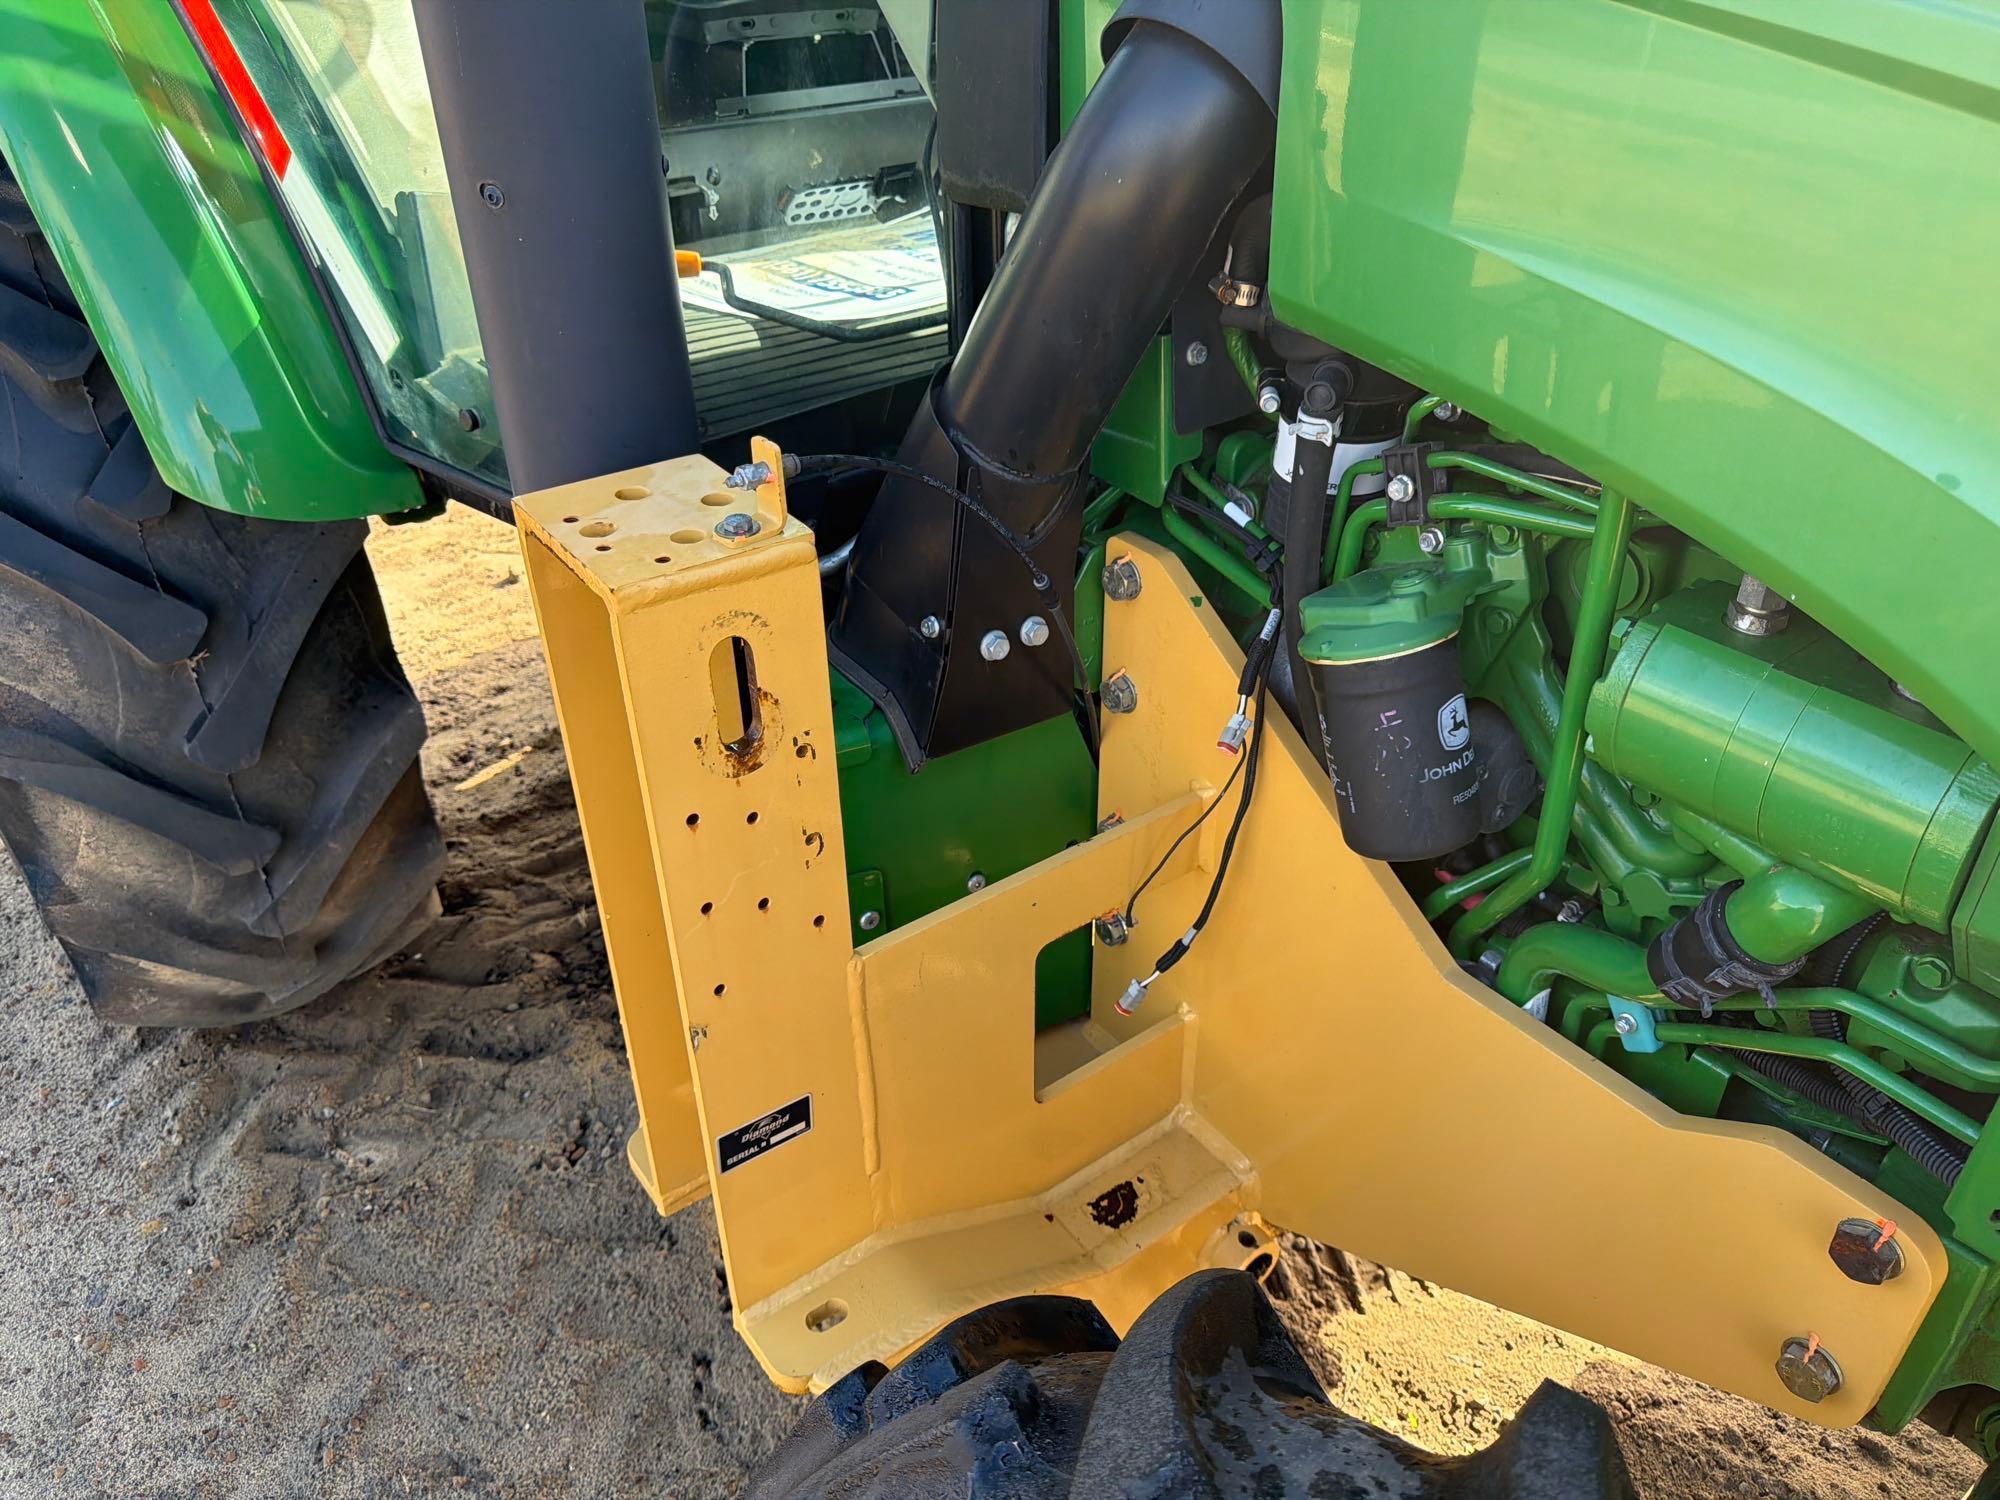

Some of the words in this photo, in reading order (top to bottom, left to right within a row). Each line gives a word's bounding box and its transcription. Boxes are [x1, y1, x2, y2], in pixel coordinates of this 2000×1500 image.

[1419, 758, 1463, 783] JOHN
[741, 1113, 790, 1143] Diamond
[727, 1145, 760, 1166] SERIAL
